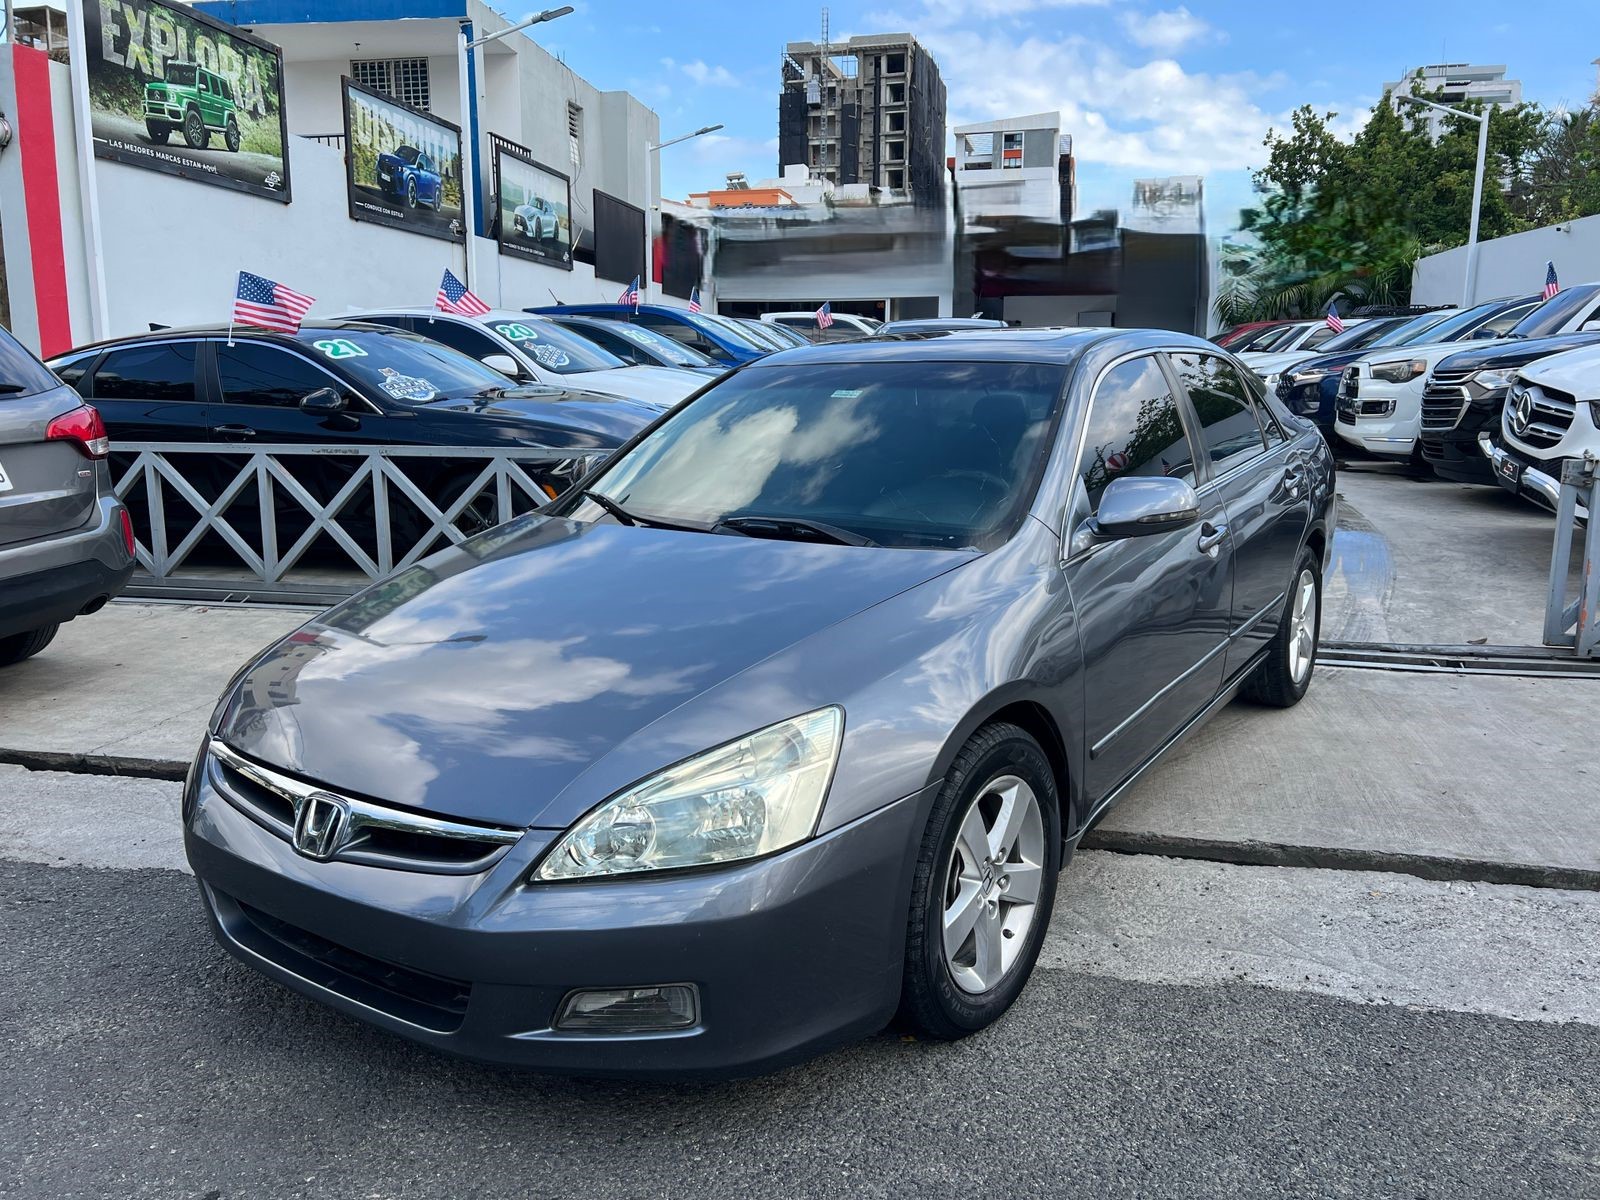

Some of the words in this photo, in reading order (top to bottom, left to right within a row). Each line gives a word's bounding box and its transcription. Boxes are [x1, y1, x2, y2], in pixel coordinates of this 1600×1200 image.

[100, 0, 266, 116] EXPLORA
[355, 96, 453, 178] DISFRUTA
[108, 139, 123, 149] LAS
[124, 143, 155, 157] MEJORES
[155, 151, 181, 164] MARCAS
[182, 158, 202, 169] ESTAN
[364, 202, 383, 213] CONDUCE
[382, 207, 391, 215] CON
[497, 325, 536, 339] 20
